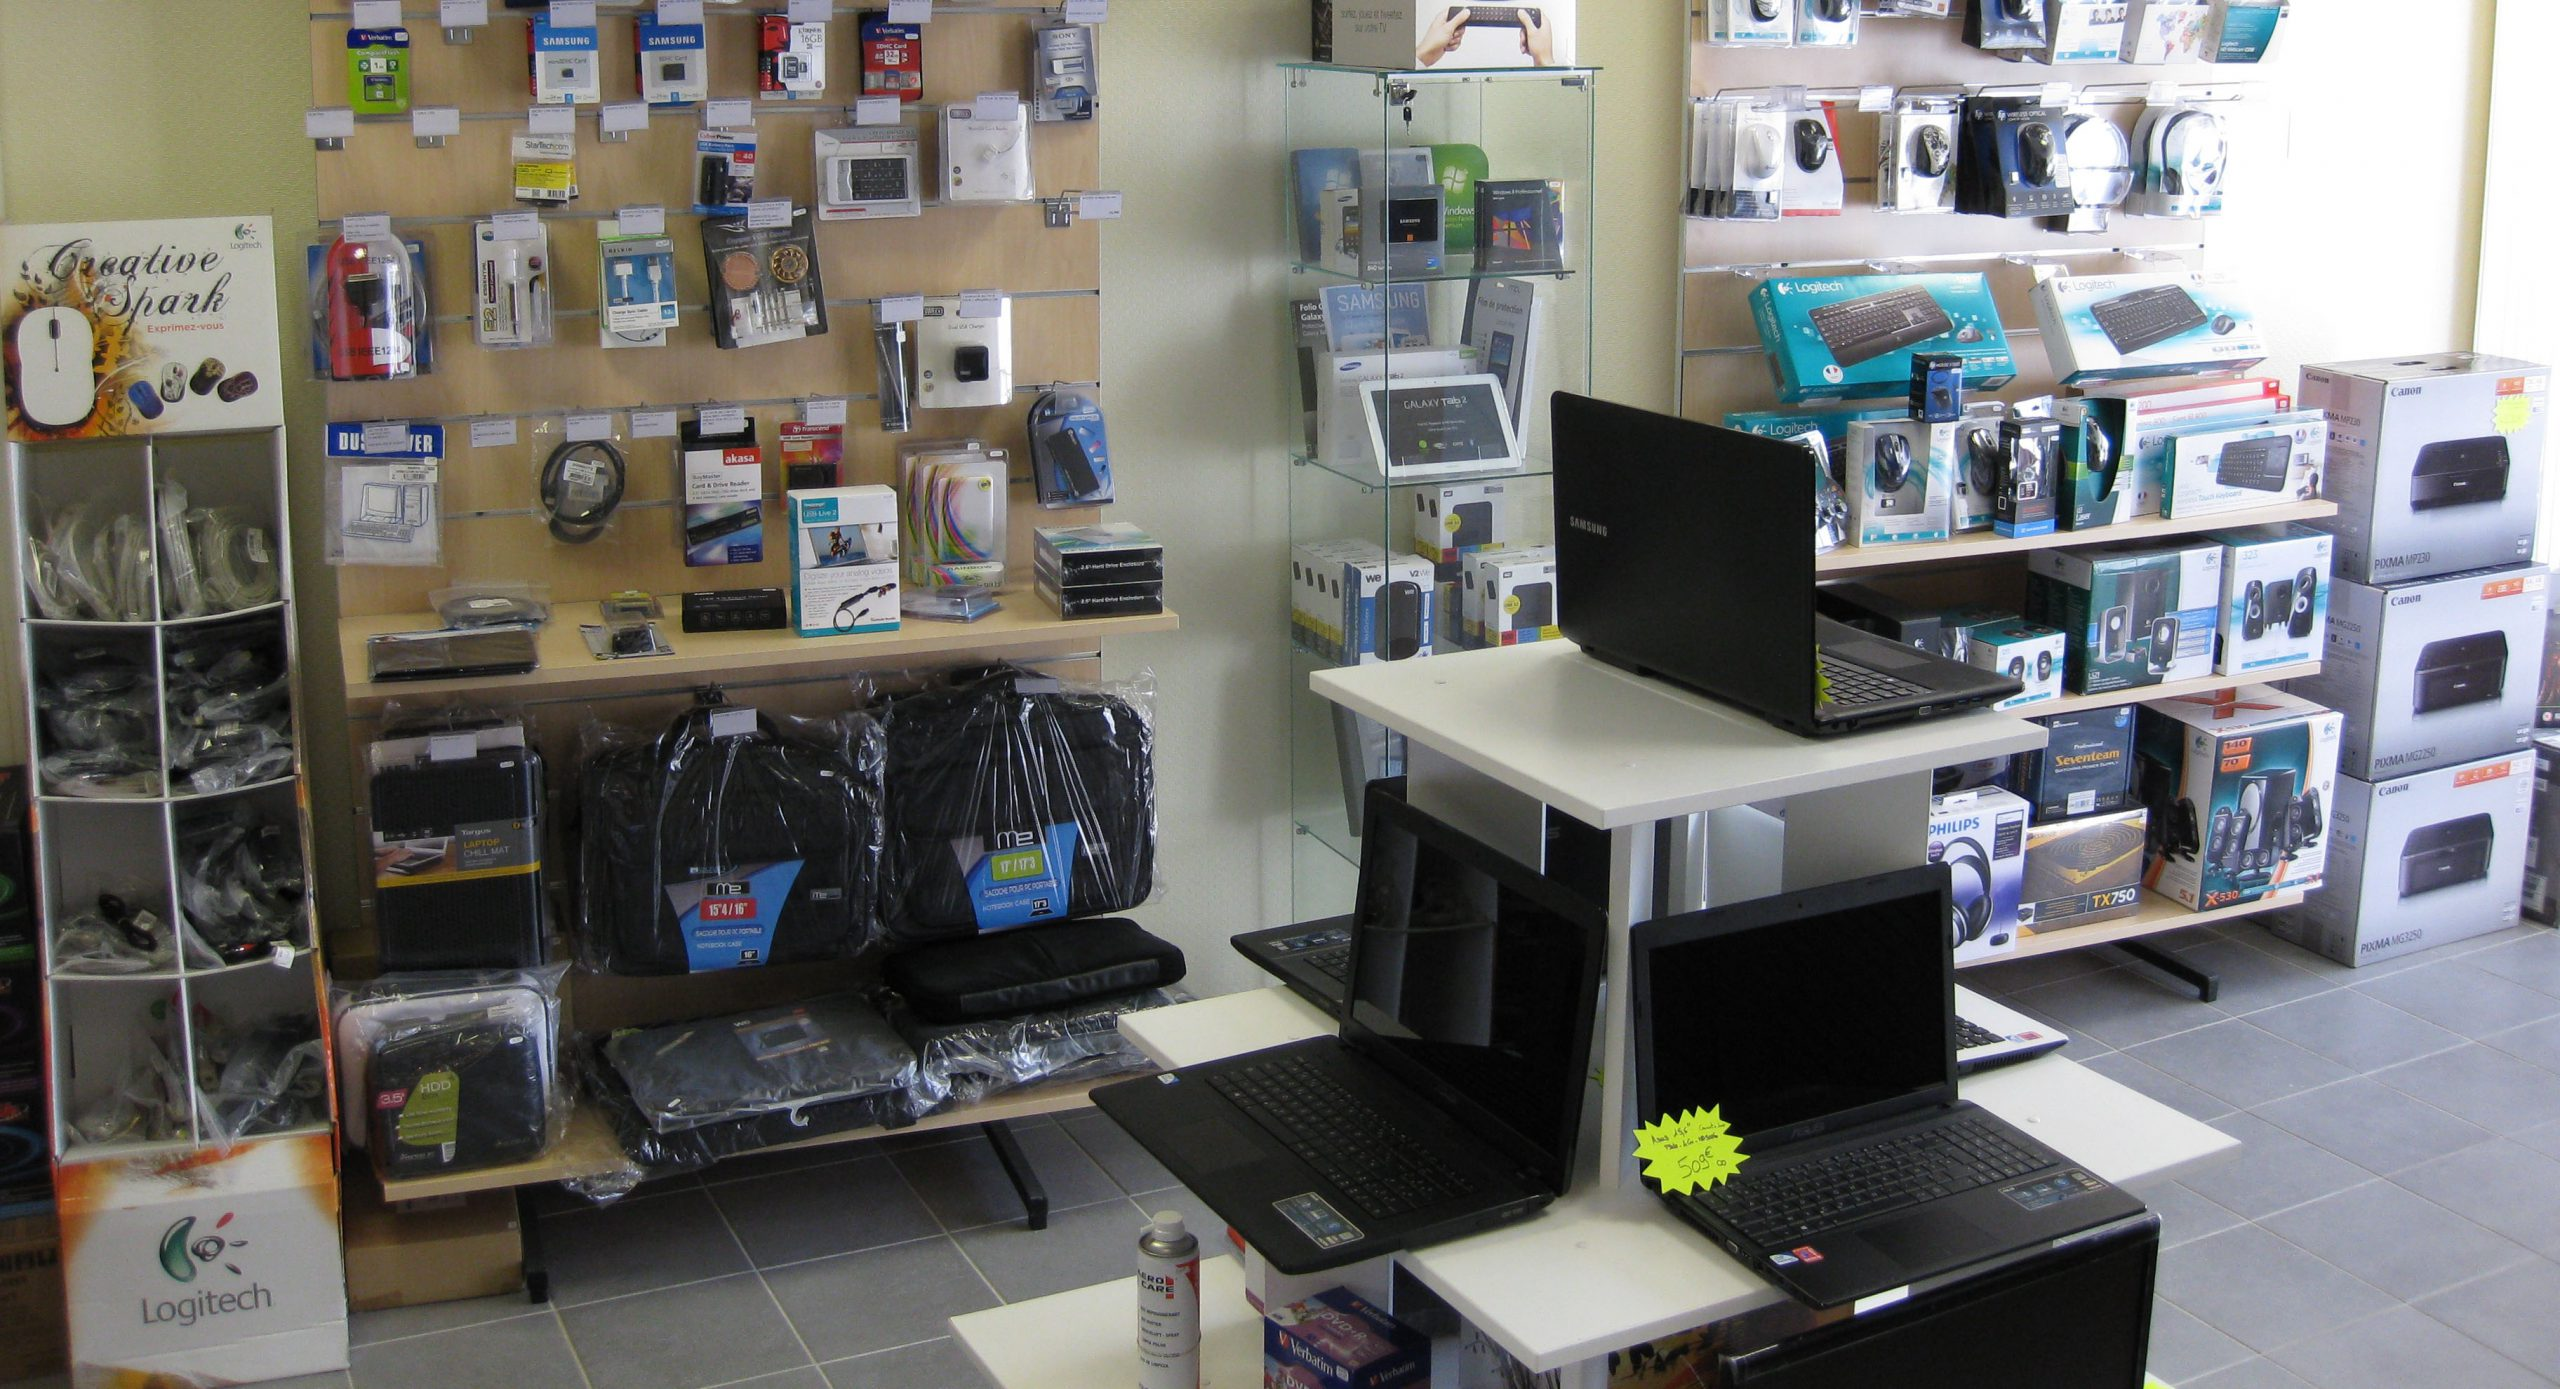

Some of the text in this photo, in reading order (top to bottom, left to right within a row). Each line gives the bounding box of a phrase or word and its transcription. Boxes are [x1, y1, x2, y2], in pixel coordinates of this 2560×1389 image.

[368, 33, 393, 42] Verbatim
[543, 37, 590, 45] SAMSUNG
[648, 36, 696, 46] SAMSUNG
[801, 34, 823, 43] 16GB
[230, 242, 263, 250] Logitech
[50, 238, 225, 281] Creative
[1795, 280, 1844, 293] Logitech
[2072, 279, 2117, 291] Logitech
[106, 273, 232, 335] Spark
[1300, 303, 1317, 312] Folio
[1337, 291, 1420, 312] SAMSUNG
[147, 324, 225, 333] Exprimez-vous
[2306, 373, 2329, 384] Canon
[2391, 386, 2422, 397] Canon
[1404, 400, 1439, 409] GALAXY
[1441, 398, 1461, 408] Tab
[1770, 420, 1818, 436] Logitech
[725, 454, 755, 464] akasa
[1569, 515, 1608, 537] SAMSUNG
[2374, 553, 2431, 570] PIXMA MP230
[1365, 574, 1382, 583] we
[2391, 593, 2421, 606] Canon
[2224, 740, 2247, 749] 140
[2055, 750, 2120, 767] Seventeam
[2223, 758, 2239, 767] 70
[2374, 753, 2404, 769] PIXMA
[2379, 783, 2409, 797] Canon
[461, 828, 491, 836] Targus
[1929, 817, 1980, 836] PHILIPS
[463, 838, 500, 848] LAPTOP
[491, 846, 509, 855] MAT
[2092, 888, 2136, 909] TX750
[2205, 890, 2240, 908] X-530
[2361, 929, 2422, 954] PIXMA MG3250
[421, 1081, 451, 1093] HDD
[1141, 1281, 1174, 1293] CARE
[142, 1282, 272, 1326] Logitech
[1360, 1304, 1396, 1329] Verbatim
[1290, 1338, 1333, 1376] Verbatim
[1378, 1360, 1416, 1384] Verbatim
